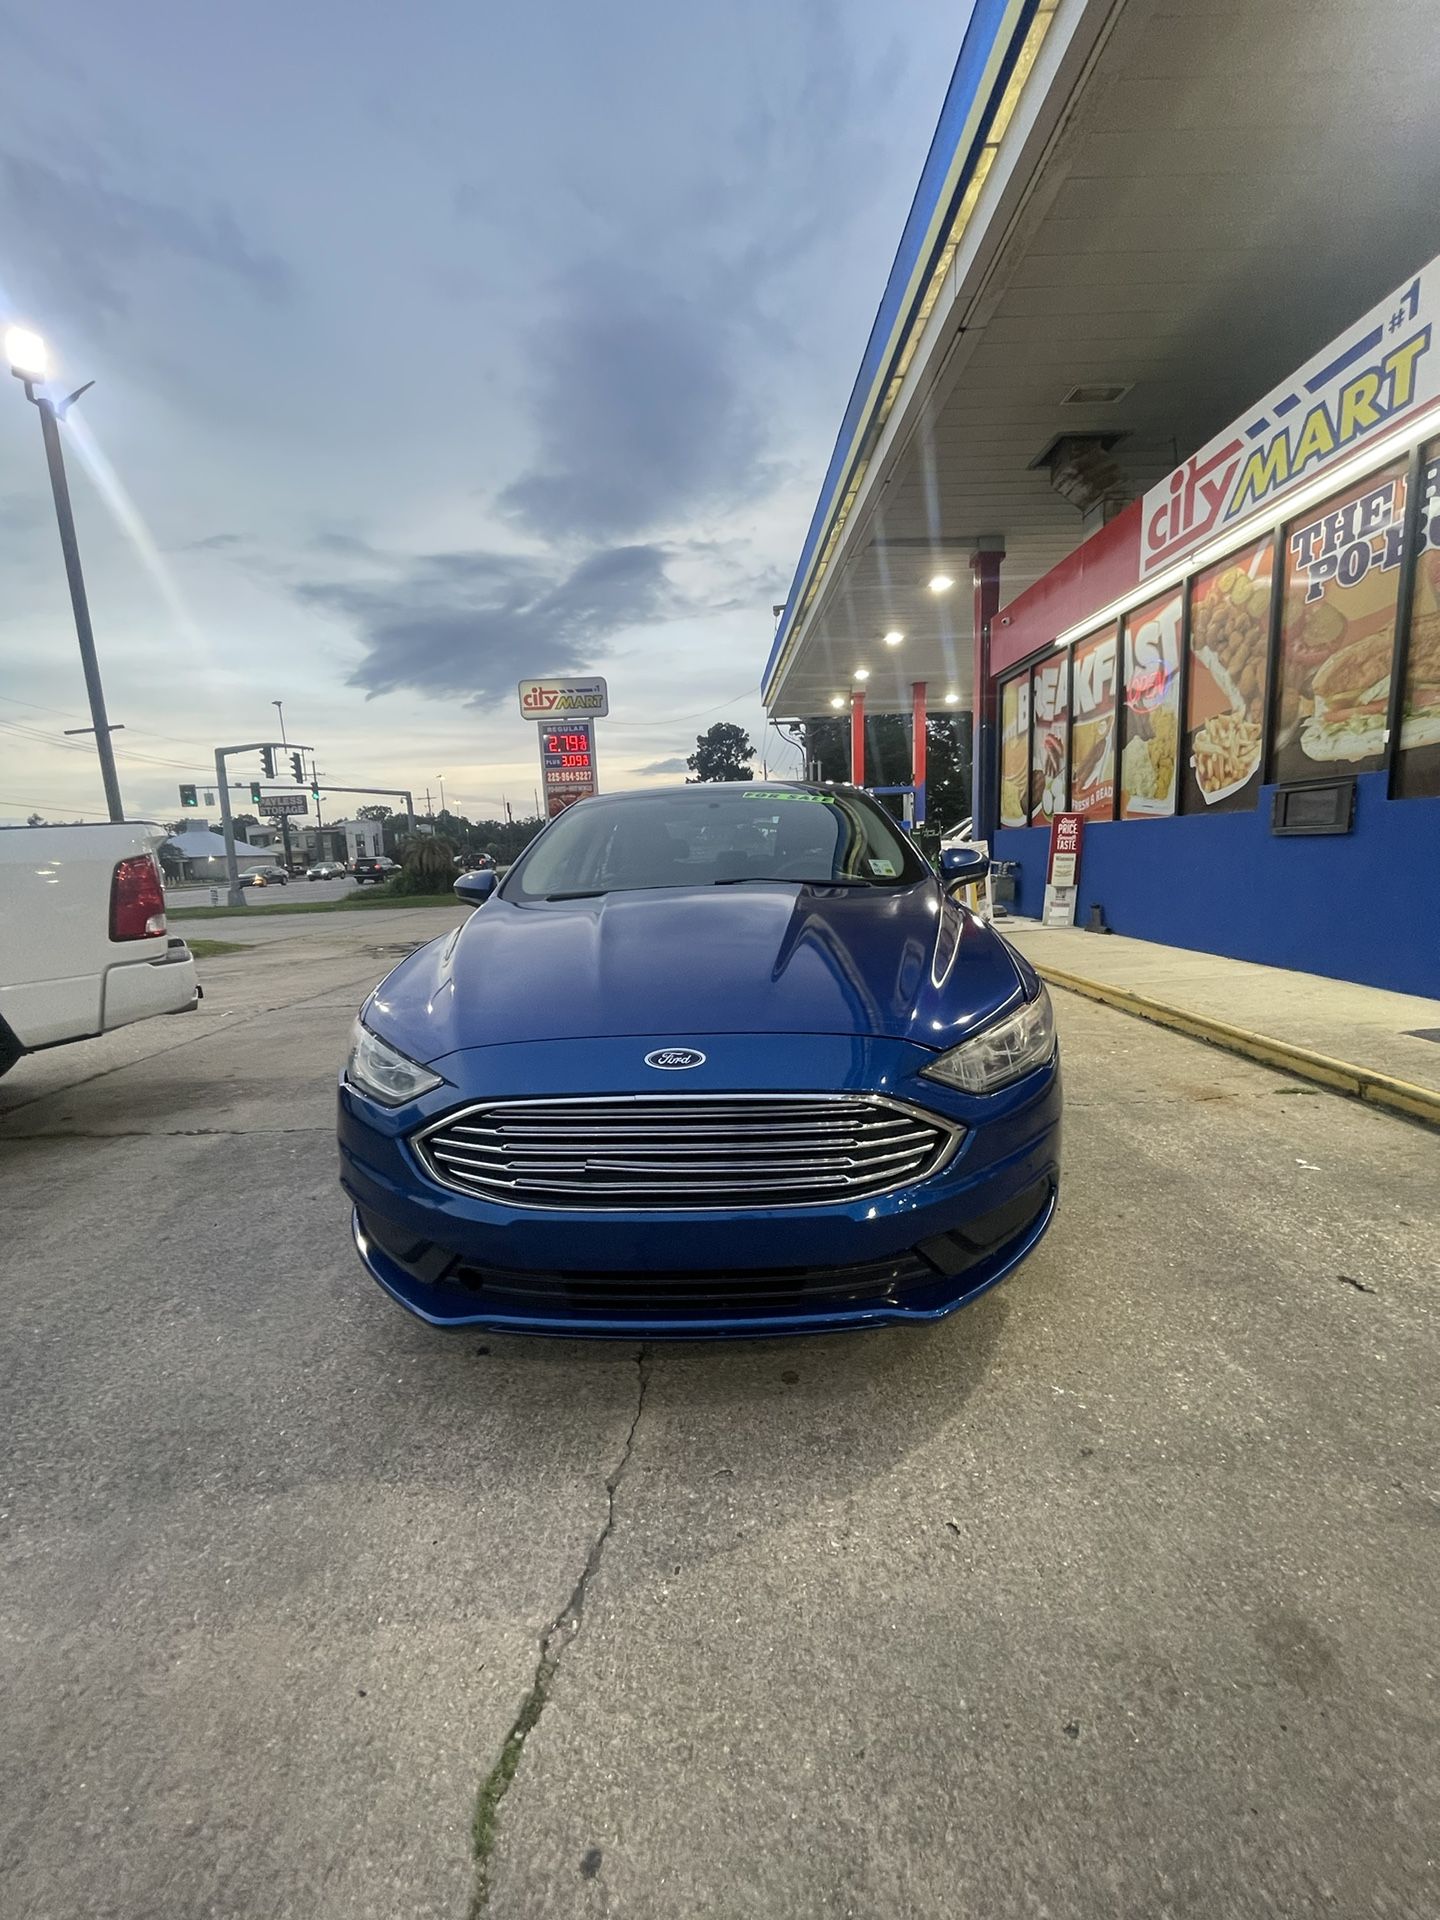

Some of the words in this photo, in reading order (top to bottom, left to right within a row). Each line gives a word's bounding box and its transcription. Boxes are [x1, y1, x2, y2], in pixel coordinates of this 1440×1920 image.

[1388, 276, 1421, 333] #1
[1290, 479, 1396, 570] THE
[744, 791, 780, 800] FOR
[786, 793, 833, 803] SALE
[260, 805, 305, 816] STORAGE
[1056, 840, 1077, 850] TASTE
[658, 1052, 692, 1065] Ford
